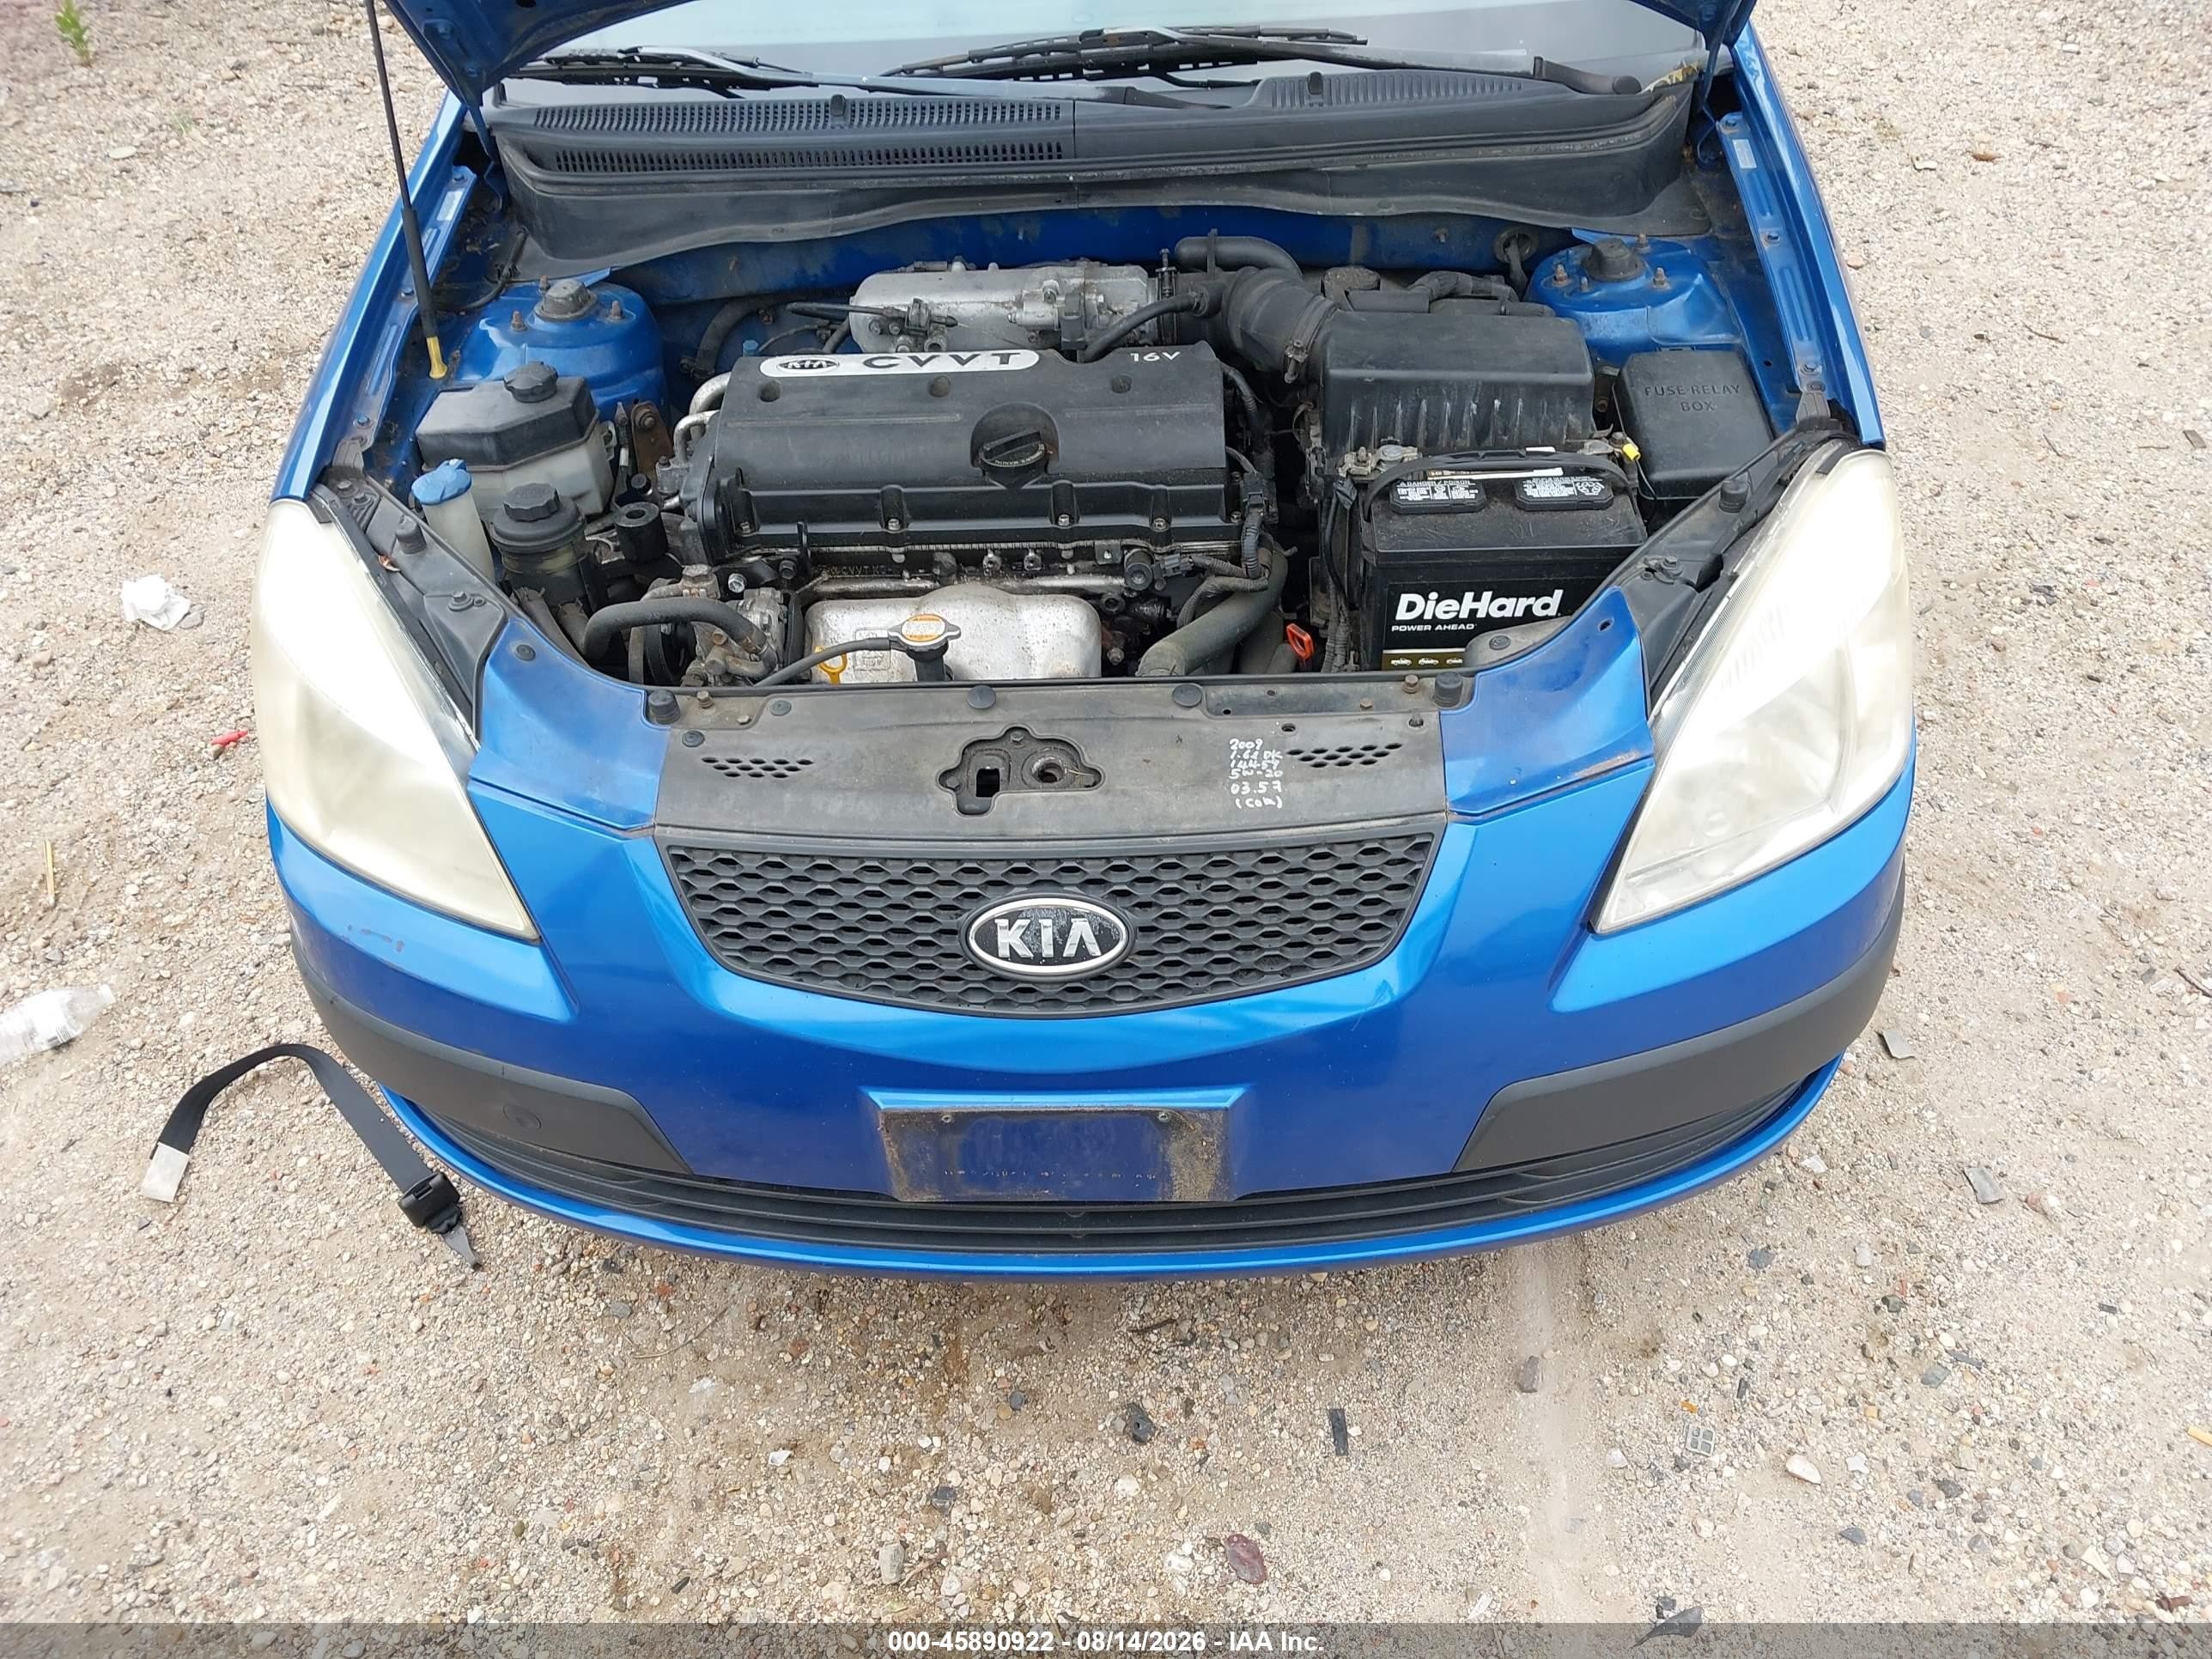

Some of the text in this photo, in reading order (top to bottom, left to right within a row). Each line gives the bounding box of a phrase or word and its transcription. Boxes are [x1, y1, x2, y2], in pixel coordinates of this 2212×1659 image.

[787, 352, 1022, 370] KIA CVVT
[1130, 351, 1181, 362] 16V
[1680, 400, 1715, 412] BOX
[1395, 589, 1564, 621] DieHard
[1391, 623, 1431, 632] POWER
[1229, 738, 1264, 750] 2009
[994, 918, 1102, 958] KIA
